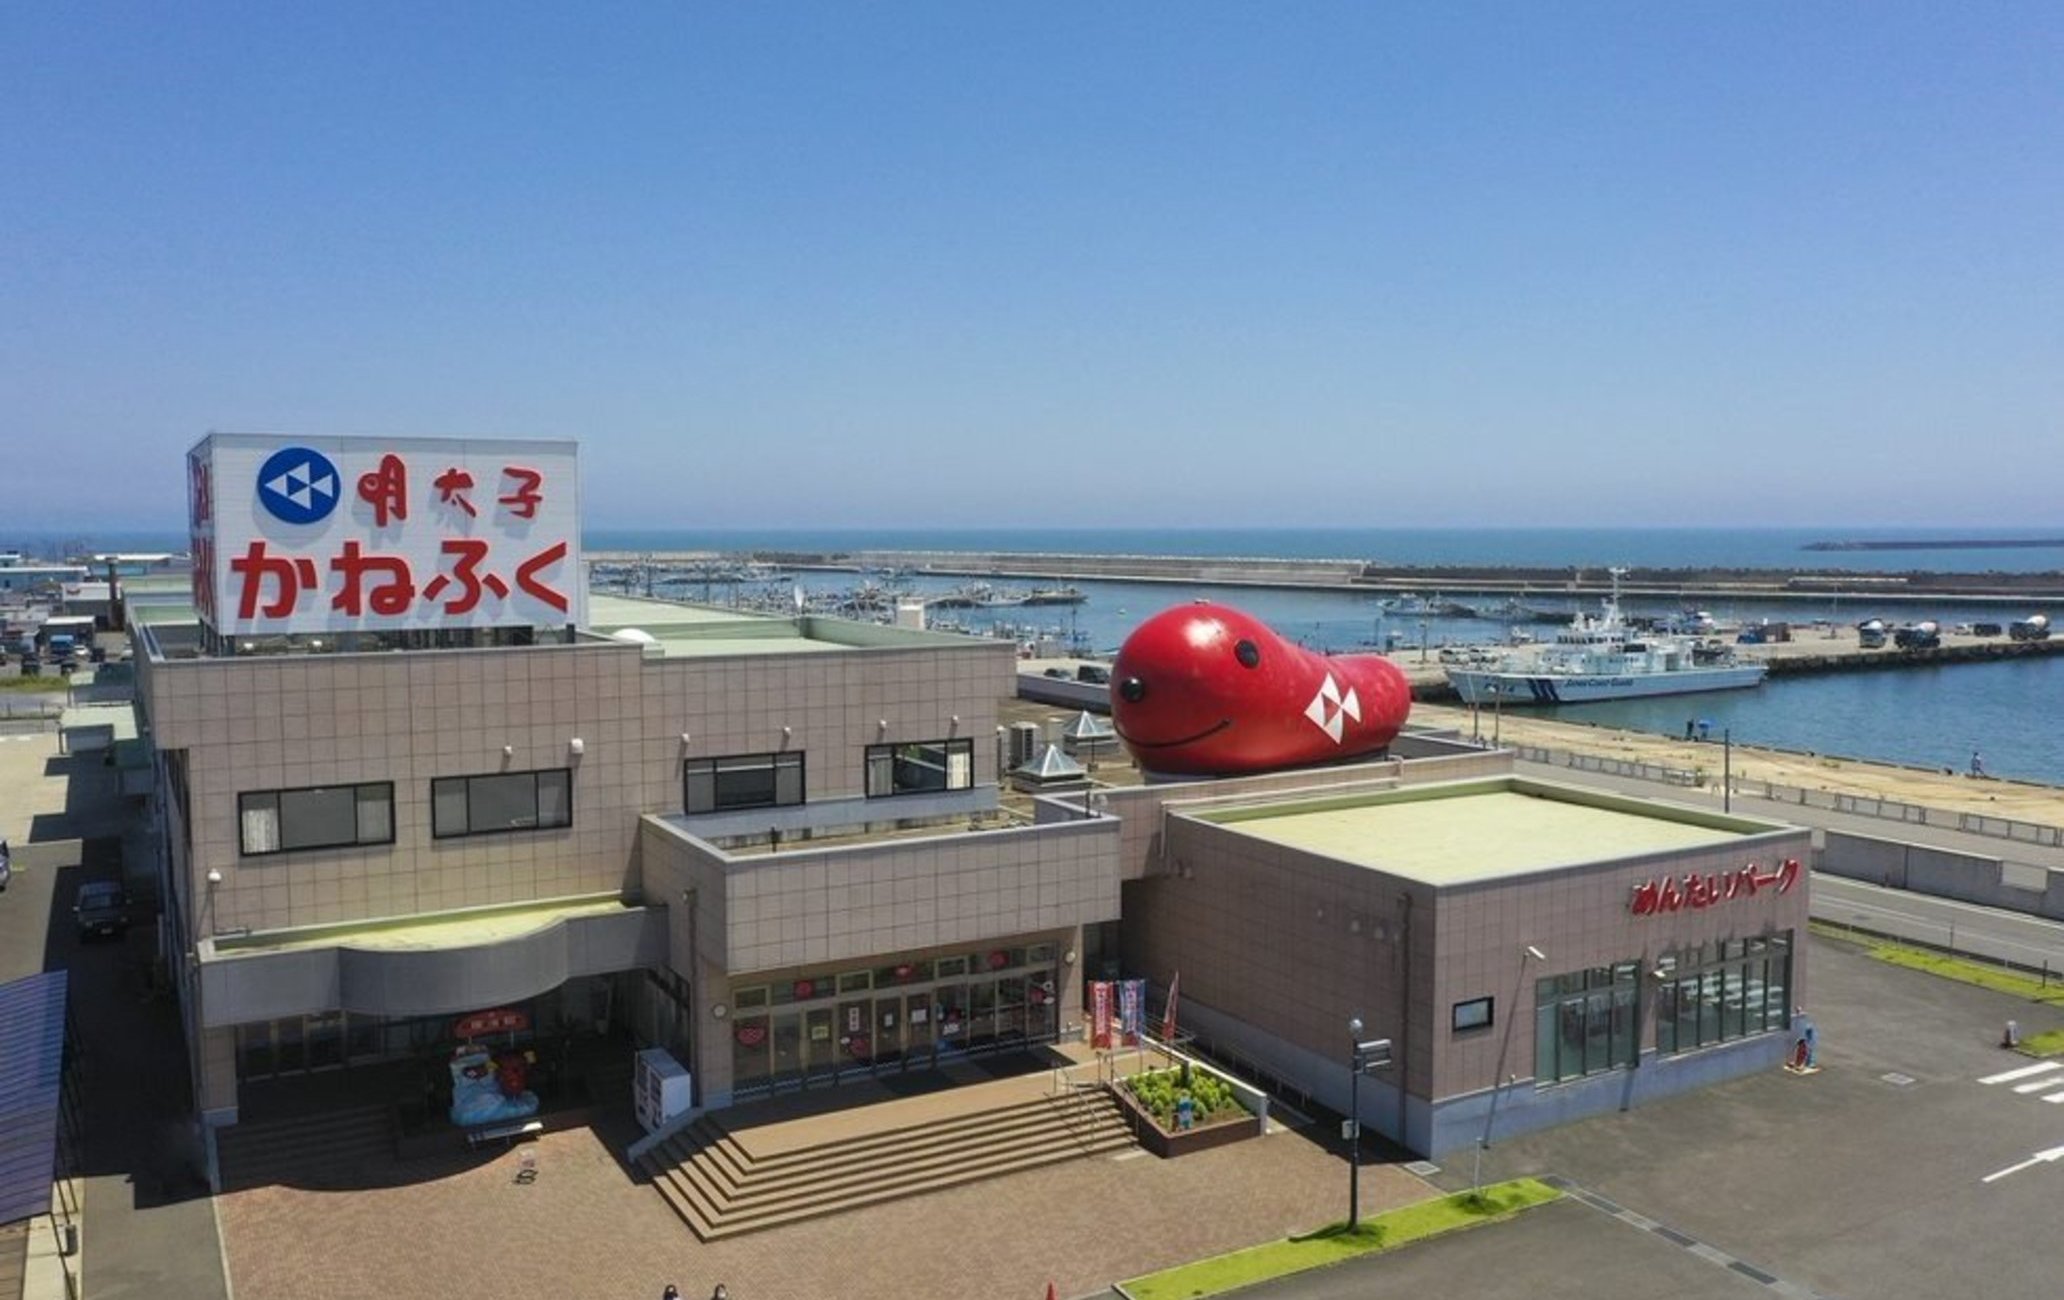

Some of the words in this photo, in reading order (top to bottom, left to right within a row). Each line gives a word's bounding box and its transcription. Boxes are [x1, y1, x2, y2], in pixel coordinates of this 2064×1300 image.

[357, 454, 543, 527] 明太子
[230, 539, 569, 619] かねふく
[1631, 858, 1799, 916] めんたいパーク
